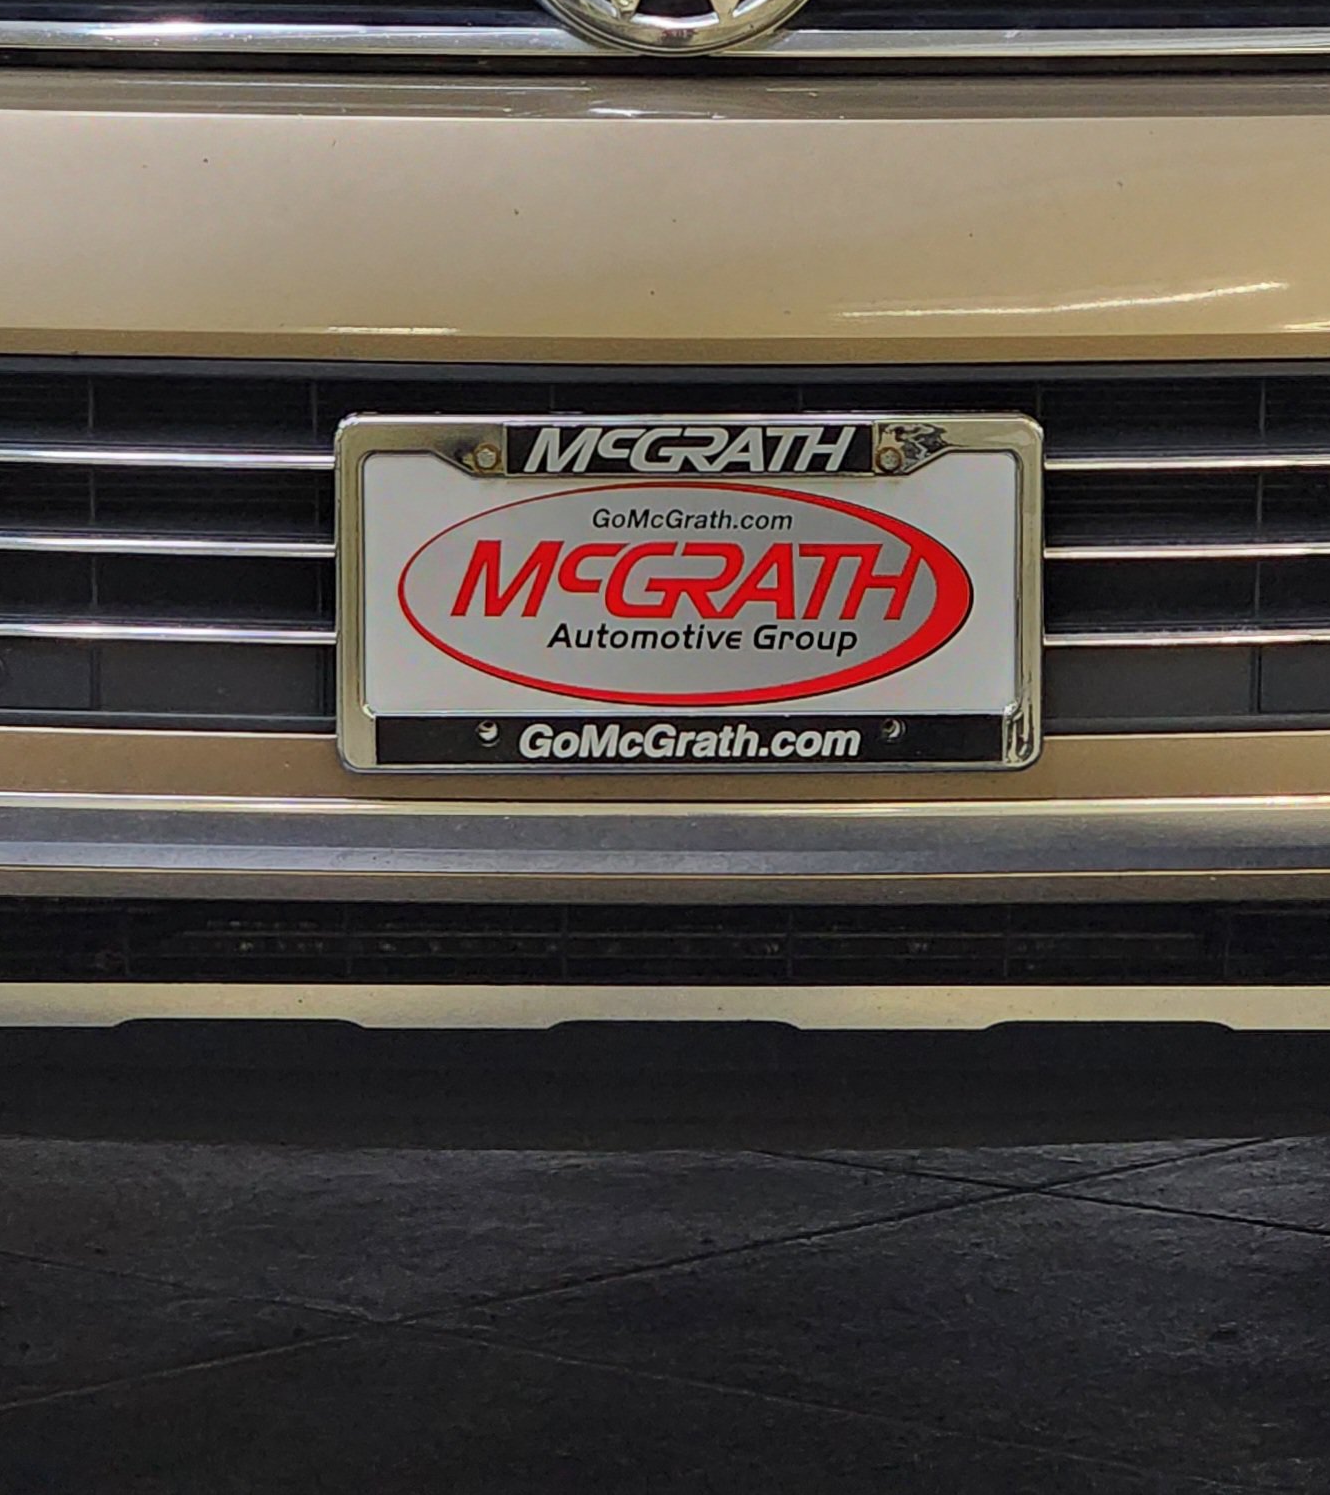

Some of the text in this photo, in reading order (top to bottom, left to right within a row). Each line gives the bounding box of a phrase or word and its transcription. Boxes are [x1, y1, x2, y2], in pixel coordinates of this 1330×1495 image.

[592, 507, 793, 532] GoMcGrath.com
[547, 623, 858, 657] Automotive Group
[518, 722, 860, 759] GoMcGrath.com
